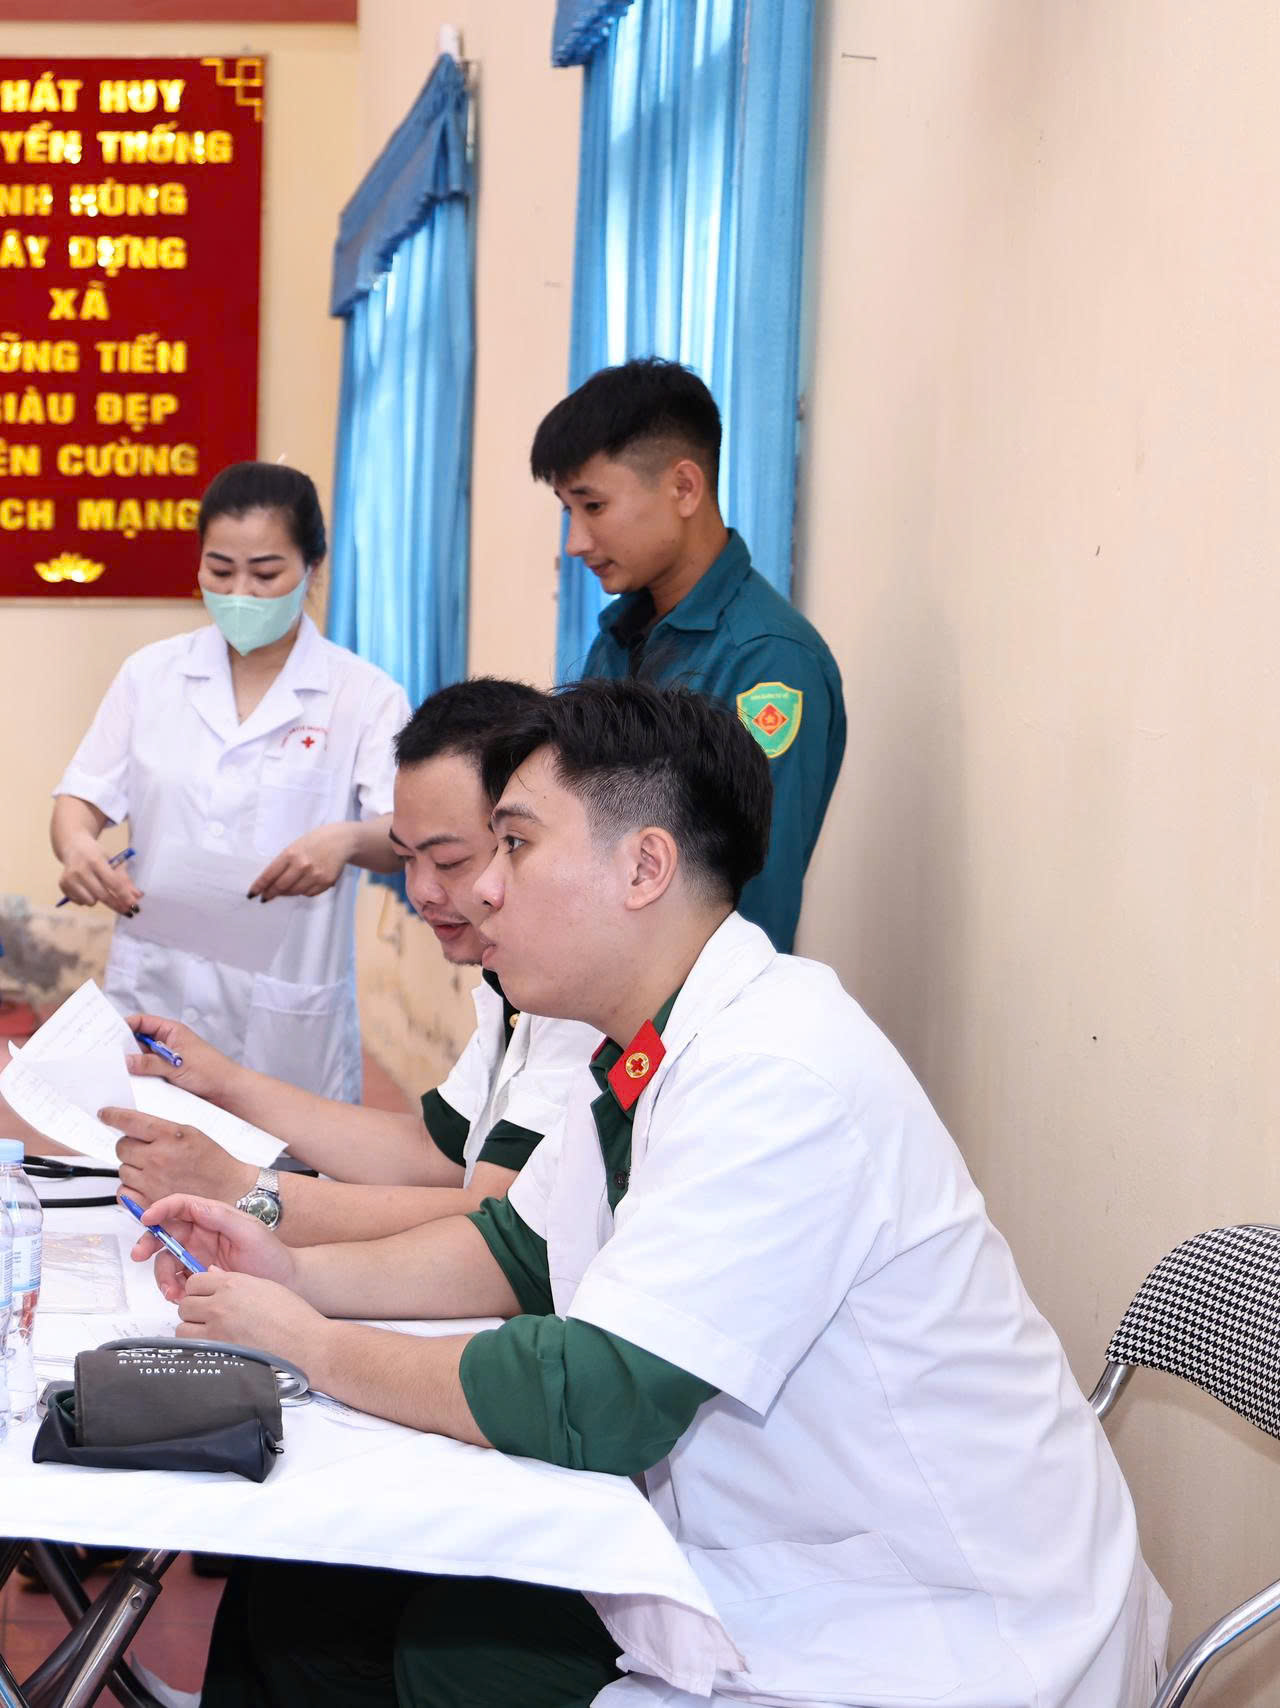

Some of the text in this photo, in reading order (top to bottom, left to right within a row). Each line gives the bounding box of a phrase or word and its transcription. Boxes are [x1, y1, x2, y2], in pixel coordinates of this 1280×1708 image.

[99, 79, 186, 113] HUY
[96, 121, 233, 164] THỐNG
[69, 177, 188, 217] HÙNG
[68, 235, 188, 277] DỰNG
[48, 280, 110, 320] XÃ
[95, 332, 188, 374] TIẾN
[94, 392, 179, 432] ĐẸP
[57, 436, 199, 477] CƯỜNG
[77, 498, 201, 538] MẠNG
